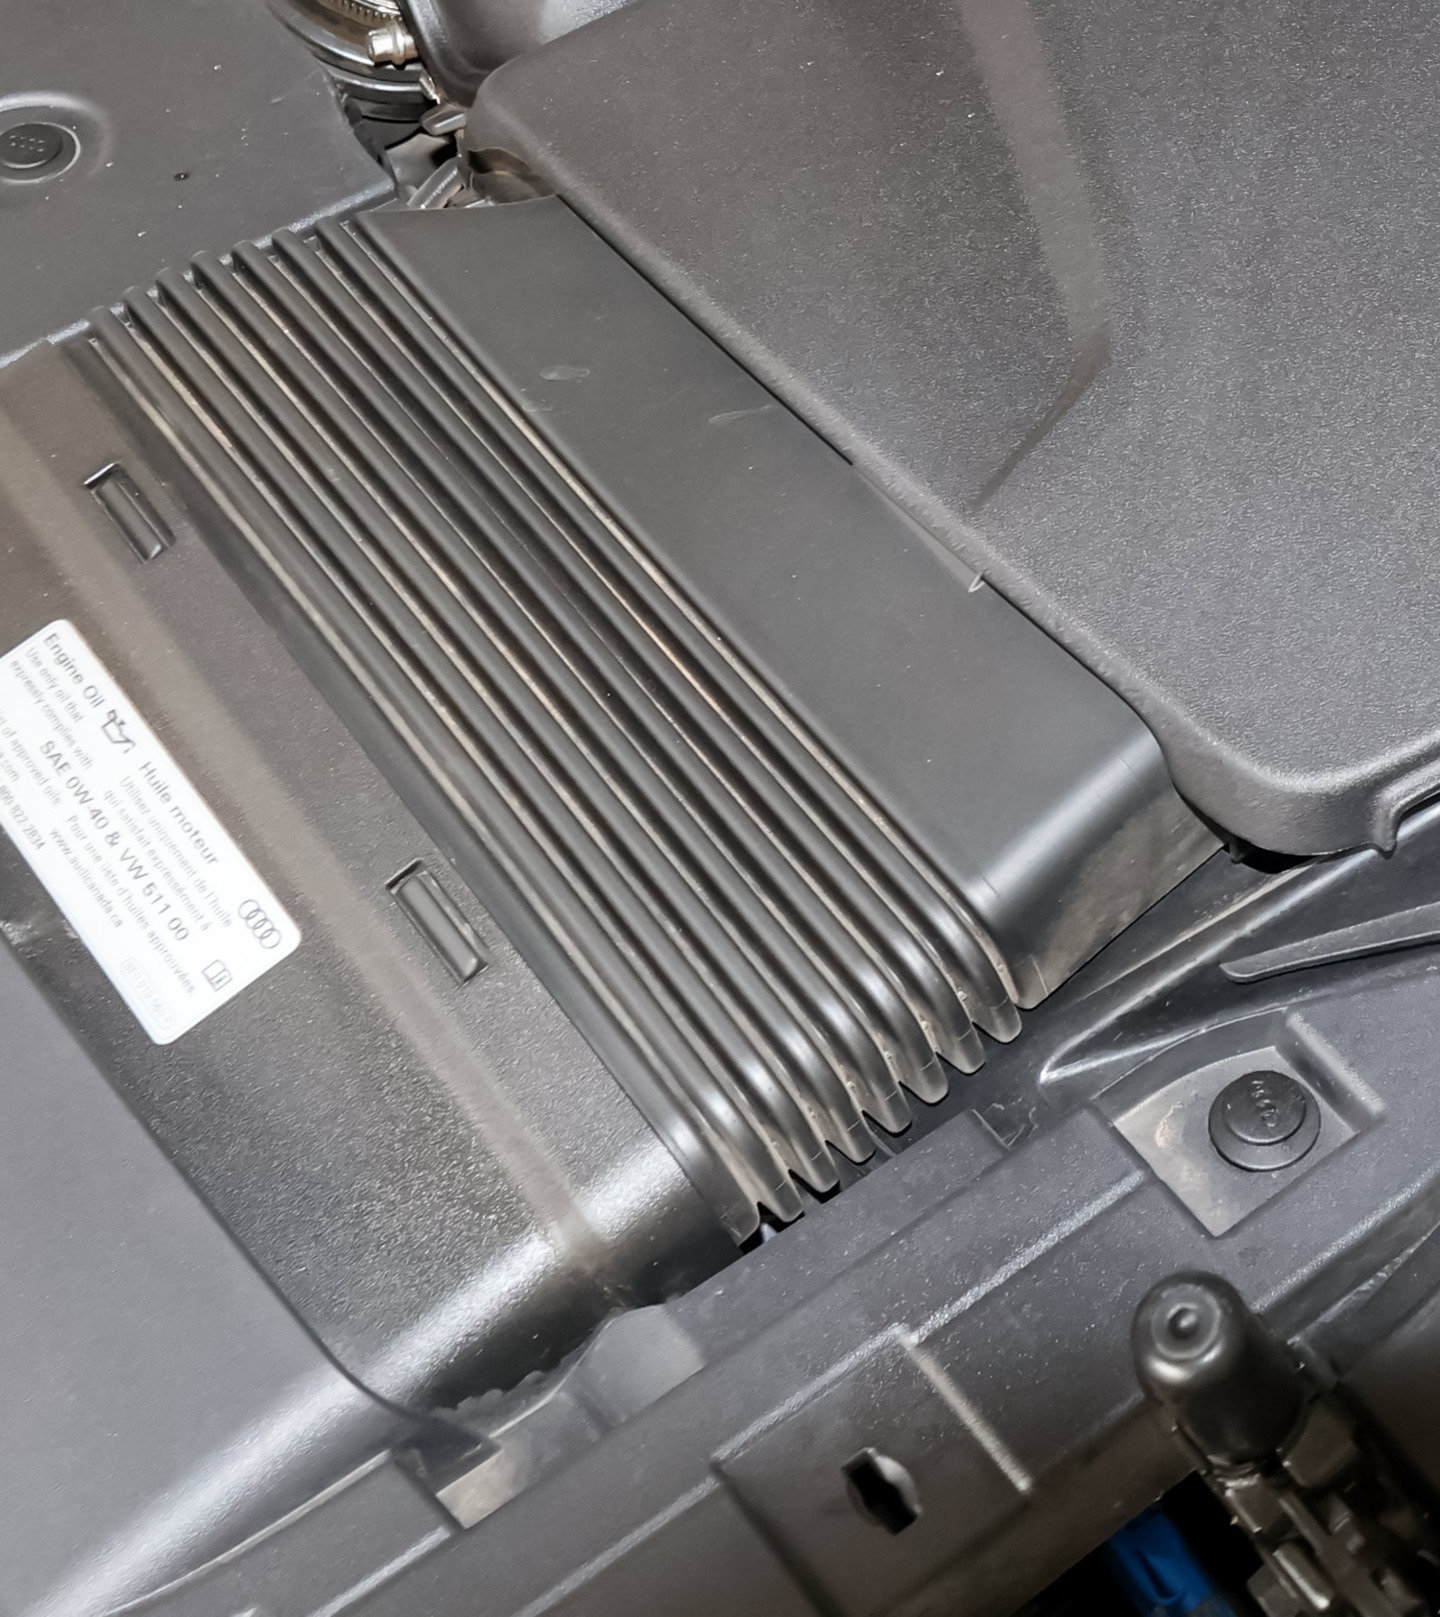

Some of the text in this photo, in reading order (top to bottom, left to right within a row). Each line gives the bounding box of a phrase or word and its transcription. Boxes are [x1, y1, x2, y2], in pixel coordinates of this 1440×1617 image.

[9, 659, 94, 769] expressly complies with
[26, 646, 84, 723] Use only oil that
[42, 631, 106, 708] Engine Oil
[8, 737, 50, 787] approved
[137, 759, 218, 865] Huile moteur
[41, 739, 189, 941] SAE 0W-40 & VW 511 00
[48, 828, 124, 928] www.audicanada.ca
[64, 814, 88, 841] Pour
[83, 840, 102, 863] une
[99, 864, 120, 887] liste
[102, 788, 120, 808] qui
[117, 806, 151, 848] satisfait
[146, 847, 205, 922] expressément
[118, 775, 151, 815] Utilisez
[146, 815, 198, 878] uniquement
[192, 876, 208, 894] de
